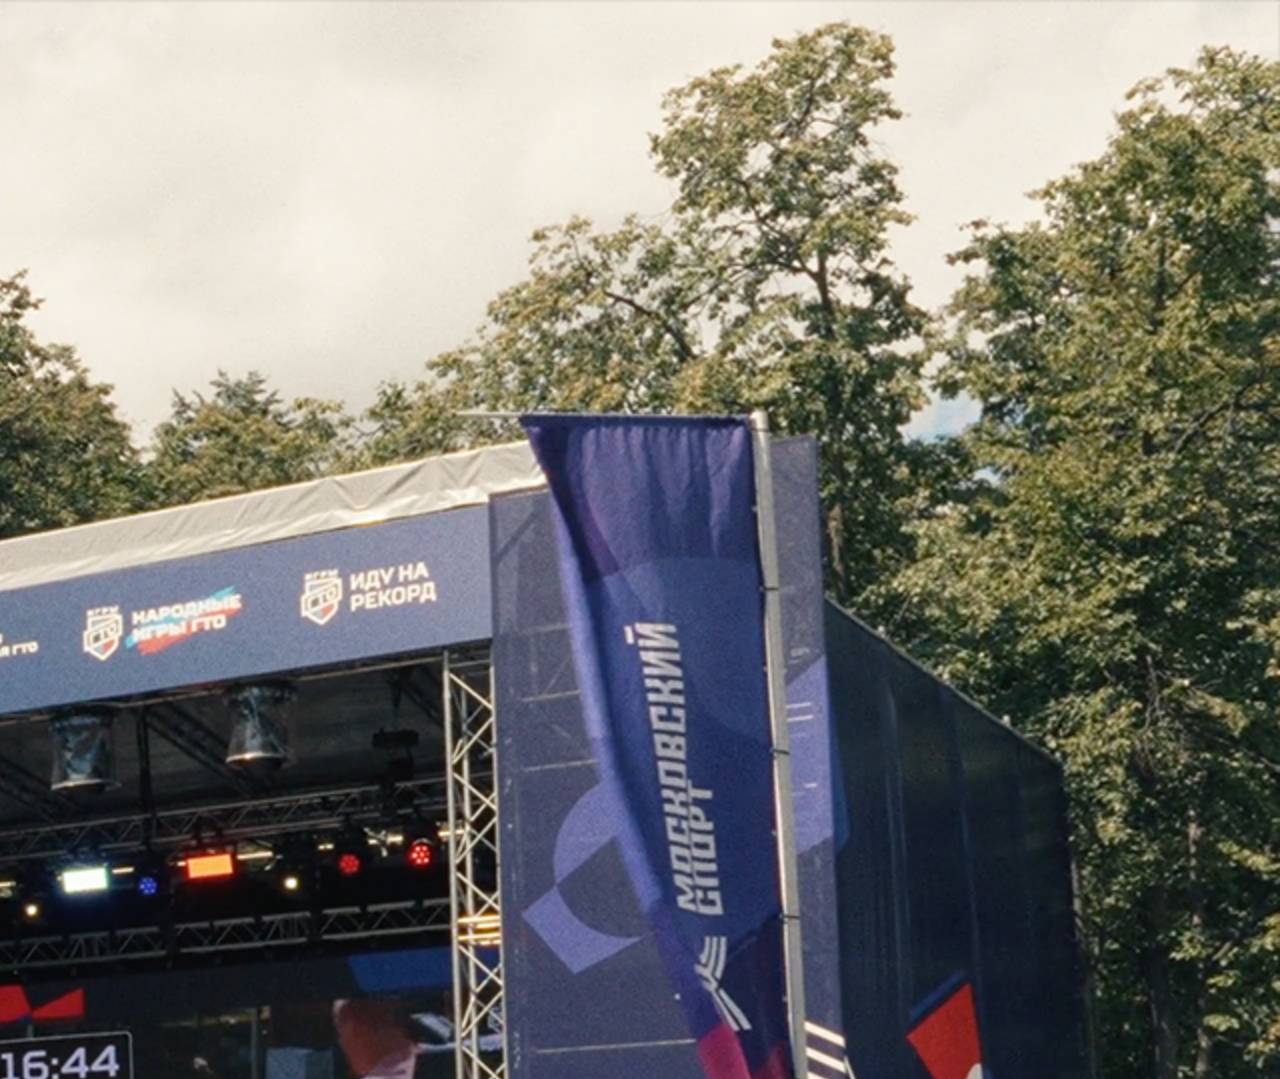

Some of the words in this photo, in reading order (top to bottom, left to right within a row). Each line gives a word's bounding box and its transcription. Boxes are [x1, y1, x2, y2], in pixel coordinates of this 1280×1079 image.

[350, 566, 394, 591] ИДУ
[398, 561, 429, 581] НА
[132, 594, 242, 625] НАРОДНЫЕ
[350, 580, 437, 612] РЕКОРД
[132, 621, 188, 644] ИГРЫ
[190, 614, 227, 634] ГТО
[12, 641, 39, 656] ГТО
[624, 622, 698, 912] МОСКОВСКИЙ
[687, 780, 724, 916] СПОРТ
